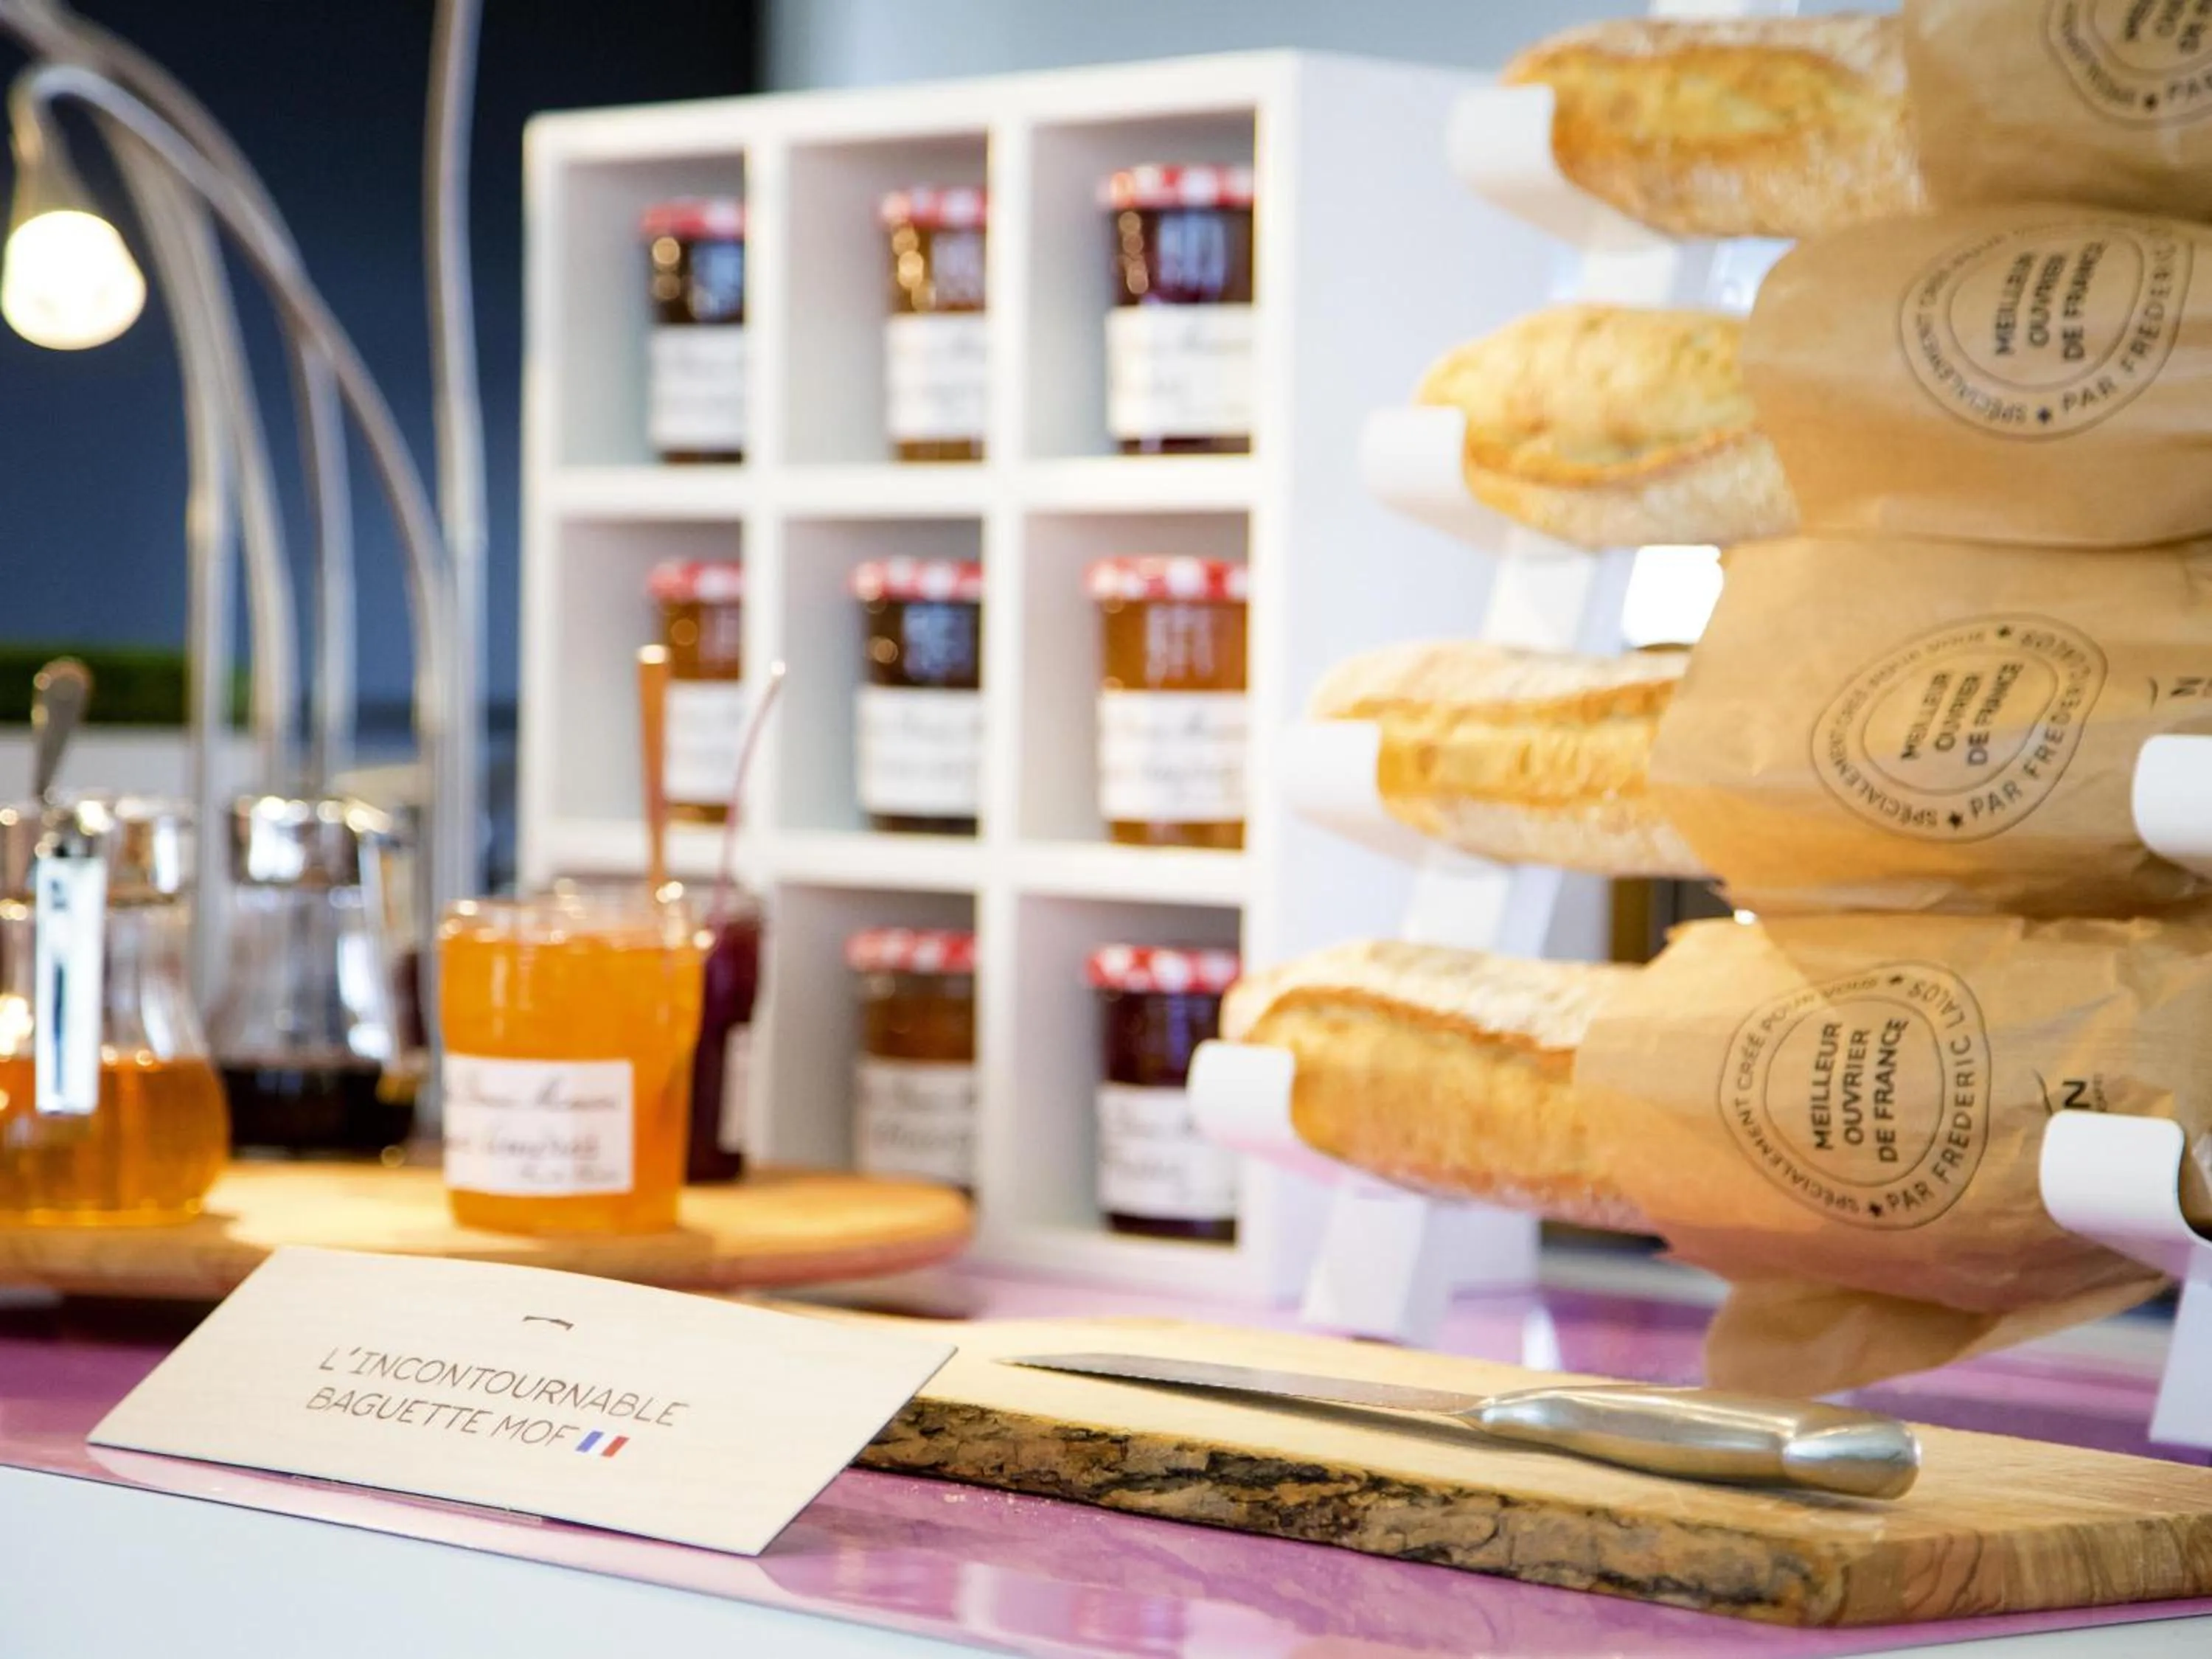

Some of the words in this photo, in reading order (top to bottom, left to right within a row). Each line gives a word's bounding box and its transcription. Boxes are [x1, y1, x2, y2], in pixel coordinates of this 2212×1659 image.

[2062, 326, 2085, 361] DE
[1967, 731, 1989, 766] DE
[1969, 780, 2023, 820] PAR
[1907, 979, 1966, 1029] LALOS
[1810, 1022, 1842, 1151] MEILLEUR
[1843, 1029, 1871, 1146] OUVRIER
[1874, 1018, 1910, 1121] FRANCE
[1931, 1034, 1975, 1184] FREDERIC
[1877, 1129, 1899, 1163] DE
[1886, 1180, 1935, 1213] PAR
[319, 1346, 690, 1427] L'INCONTOURNABLE
[306, 1386, 493, 1434] BAGUETTE
[491, 1413, 580, 1447] MOF
